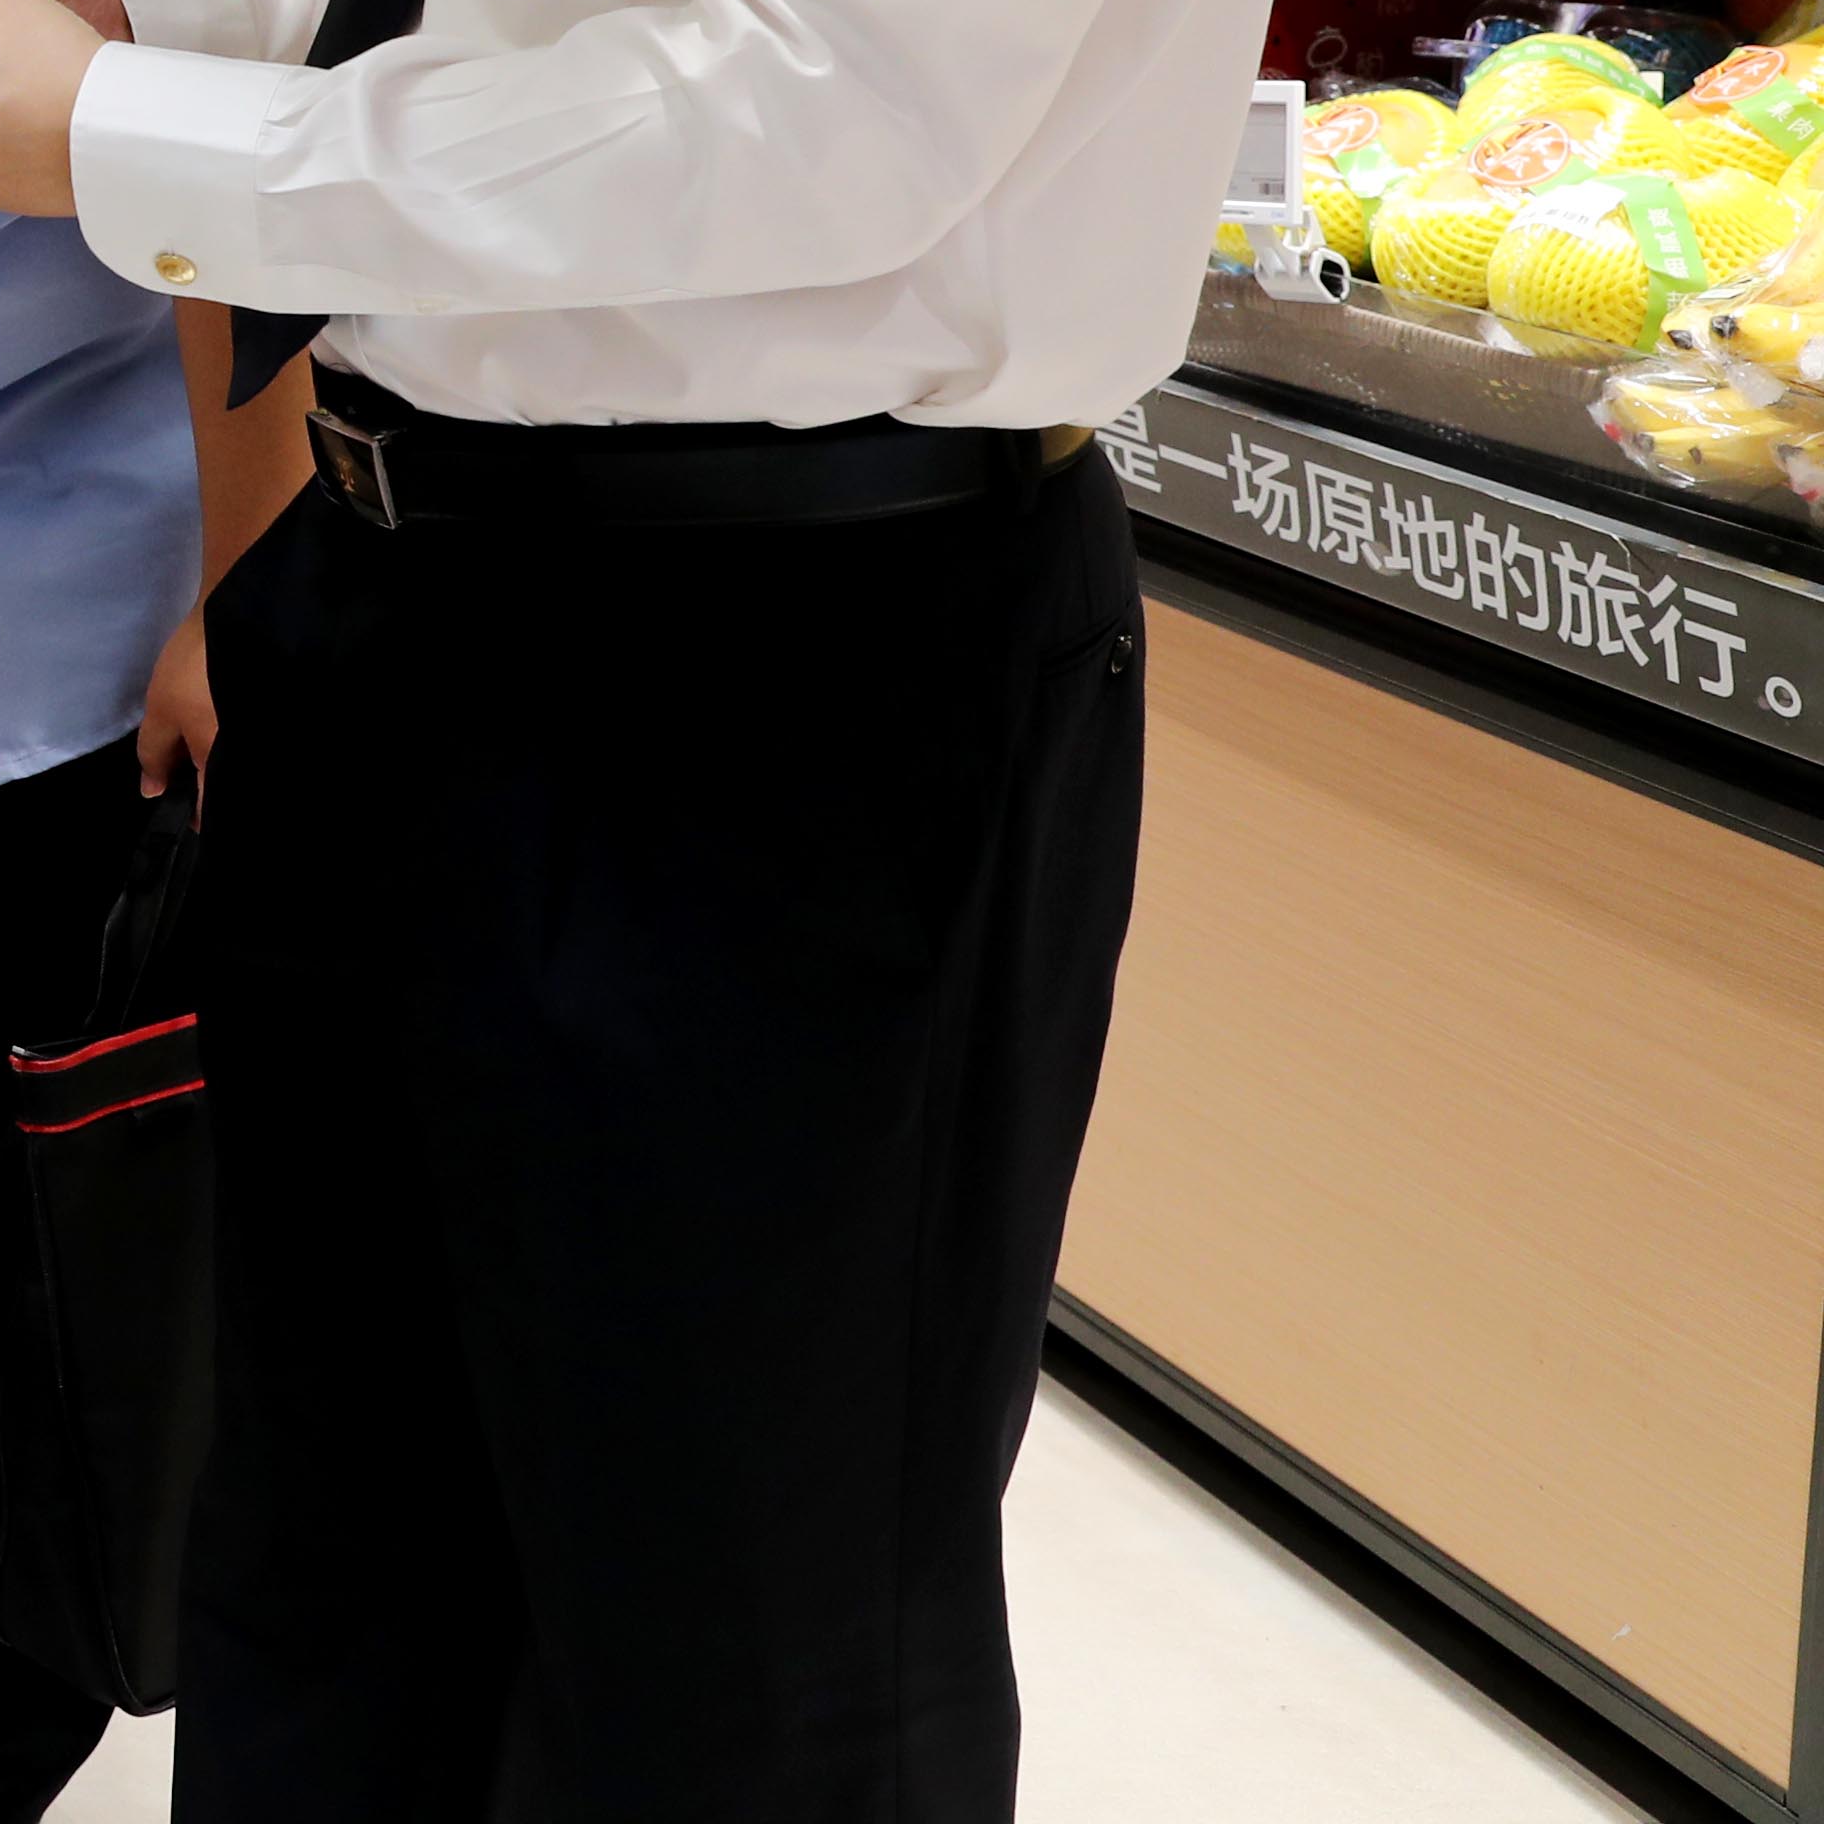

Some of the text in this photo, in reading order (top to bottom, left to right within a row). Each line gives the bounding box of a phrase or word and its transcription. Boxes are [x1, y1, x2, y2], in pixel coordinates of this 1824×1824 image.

[1095, 402, 1804, 719] 是一场原地的旅行。
